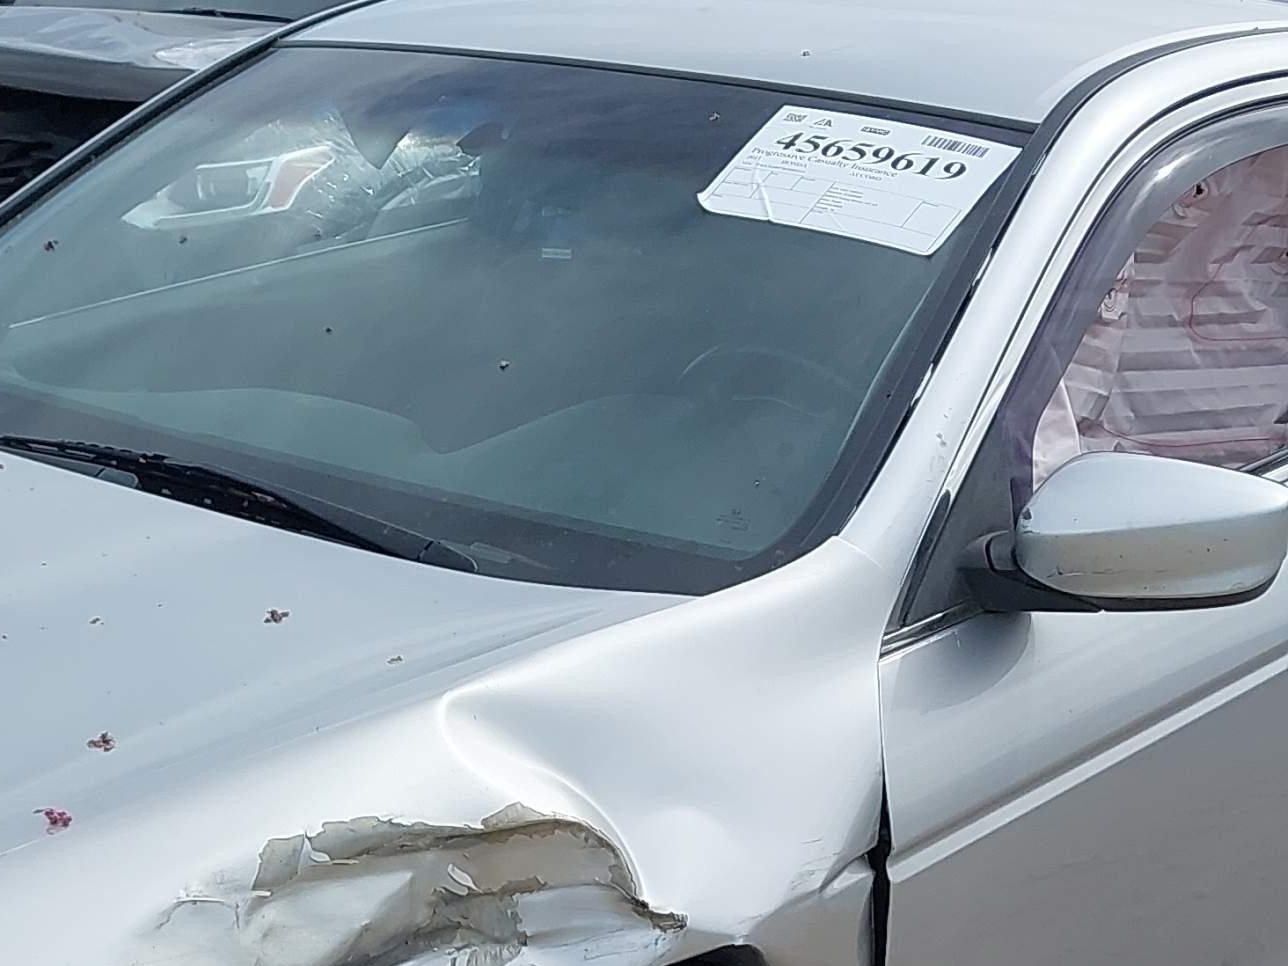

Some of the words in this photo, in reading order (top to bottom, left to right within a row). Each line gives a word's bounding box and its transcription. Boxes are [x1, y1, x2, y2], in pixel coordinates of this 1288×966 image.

[752, 147, 806, 161] Progressive
[808, 155, 848, 168] Casualty
[851, 163, 897, 177] Insurance
[776, 132, 967, 180] 45659619
